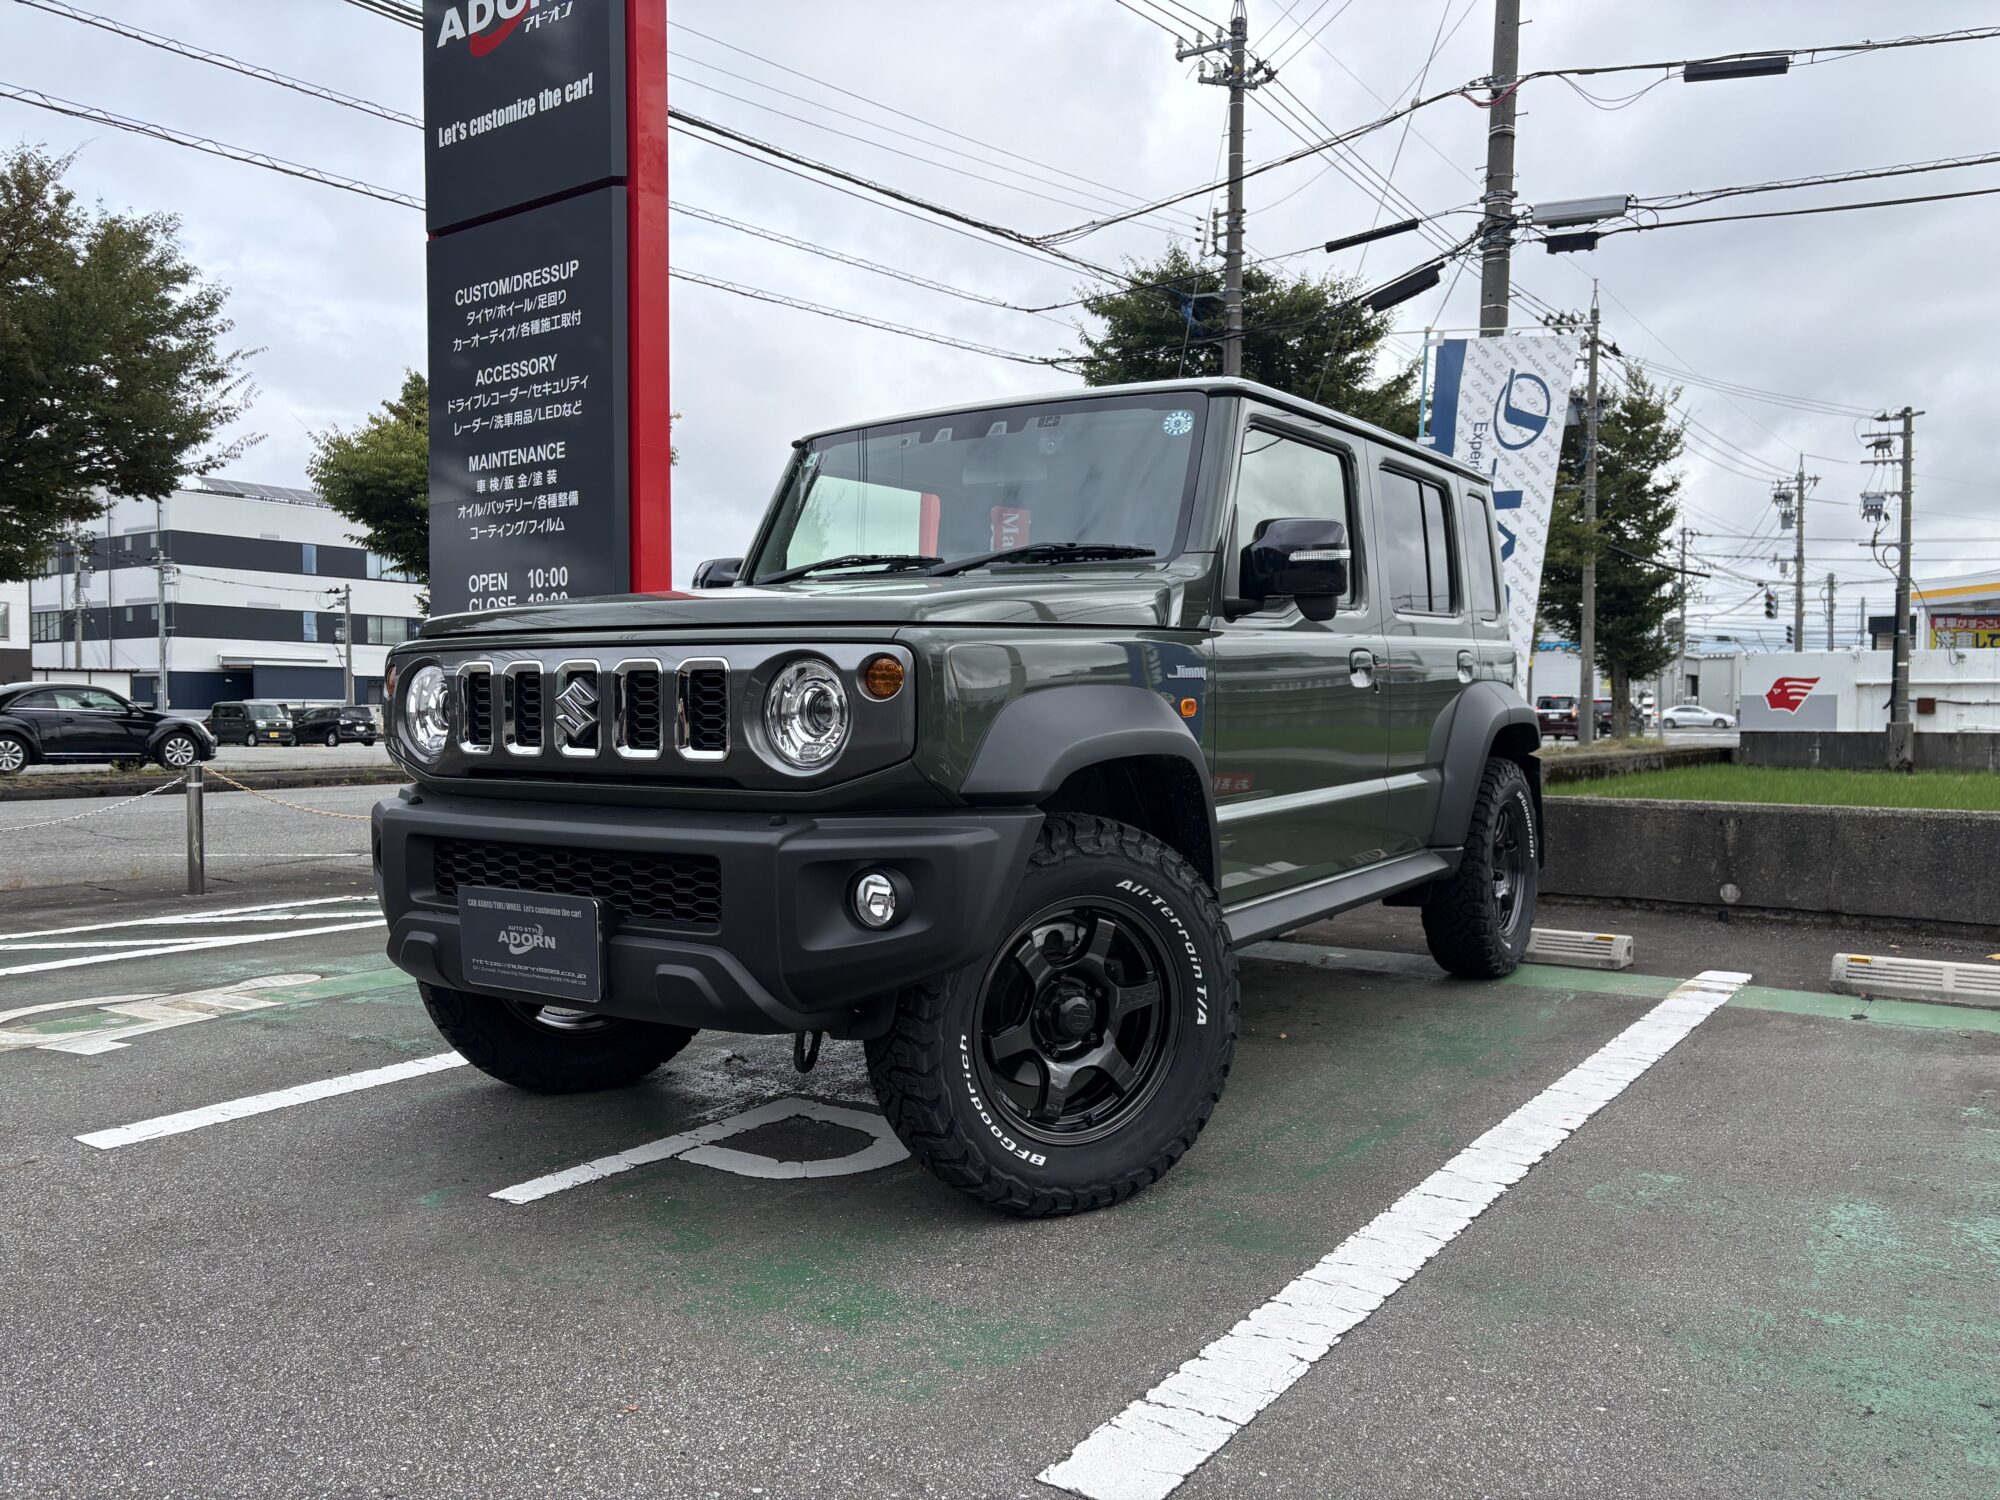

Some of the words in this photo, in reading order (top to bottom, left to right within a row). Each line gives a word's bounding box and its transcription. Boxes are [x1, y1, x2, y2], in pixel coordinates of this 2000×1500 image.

[437, 0, 554, 48] ADO
[523, 1, 573, 33] アドオン
[438, 119, 467, 149] Let's
[469, 98, 536, 137] customize
[539, 88, 562, 113] the
[565, 72, 594, 103] car!
[455, 259, 580, 307] CUSTOM/DRESSUP
[466, 289, 567, 327] タイヤ/ホイール/足回り
[452, 309, 582, 353] カーオーディオ/各種施工取付
[475, 354, 558, 387] ACCESSORY
[447, 375, 590, 415] ドライブレコーダー/セキュリティ
[453, 400, 583, 437] レーダー/洗車用品/LEDなど
[468, 441, 566, 473] MAINTENANCE
[458, 490, 580, 519] オイル/バッテリー/各種整備
[470, 517, 566, 540] コーティング/フィルム
[468, 572, 508, 593] OPEN
[527, 566, 569, 589] 10:00
[1167, 664, 1207, 681] Jimny
[535, 905, 561, 916] customize
[497, 930, 557, 950] ADORN
[507, 924, 523, 932] AUTO
[1116, 879, 1206, 980] All-Terrain
[1195, 983, 1209, 1027] T/A
[959, 1033, 1047, 1168] BFGoodrich
